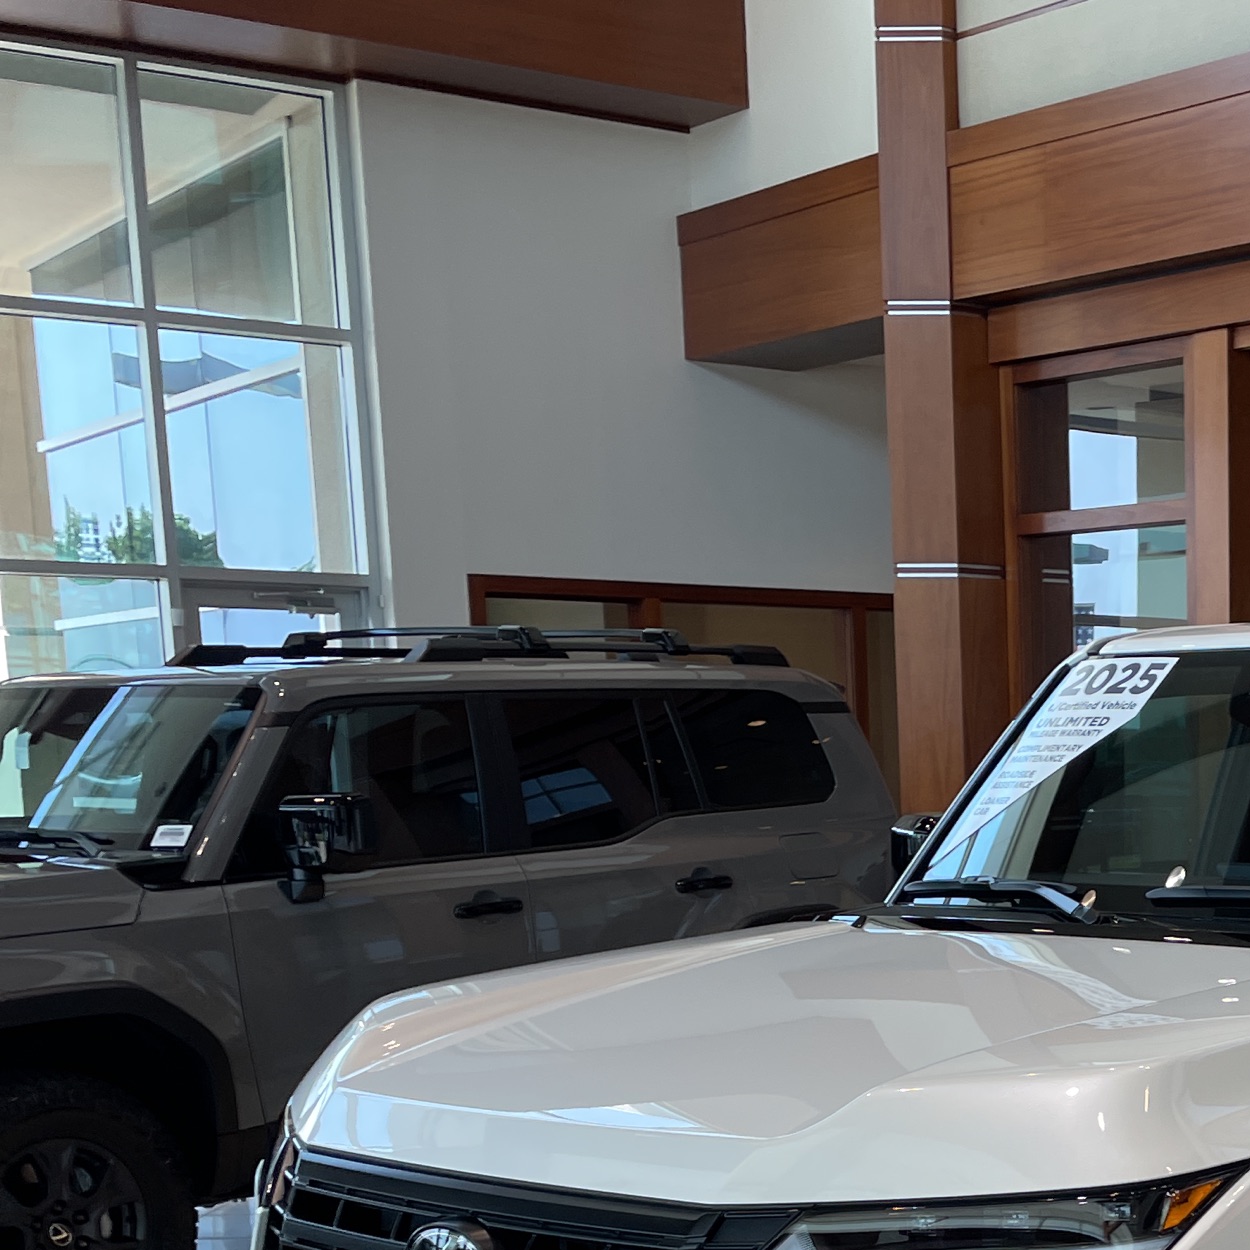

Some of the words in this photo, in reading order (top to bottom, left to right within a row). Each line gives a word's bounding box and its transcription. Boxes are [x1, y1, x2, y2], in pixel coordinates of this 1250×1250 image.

[1059, 662, 1169, 697] 2025
[1101, 700, 1137, 710] Vehicle
[1036, 716, 1110, 728] UNLIMITED
[1059, 729, 1103, 737] WARRANTY
[1009, 755, 1066, 763] MAINTENANCE
[973, 808, 990, 816] CAR
